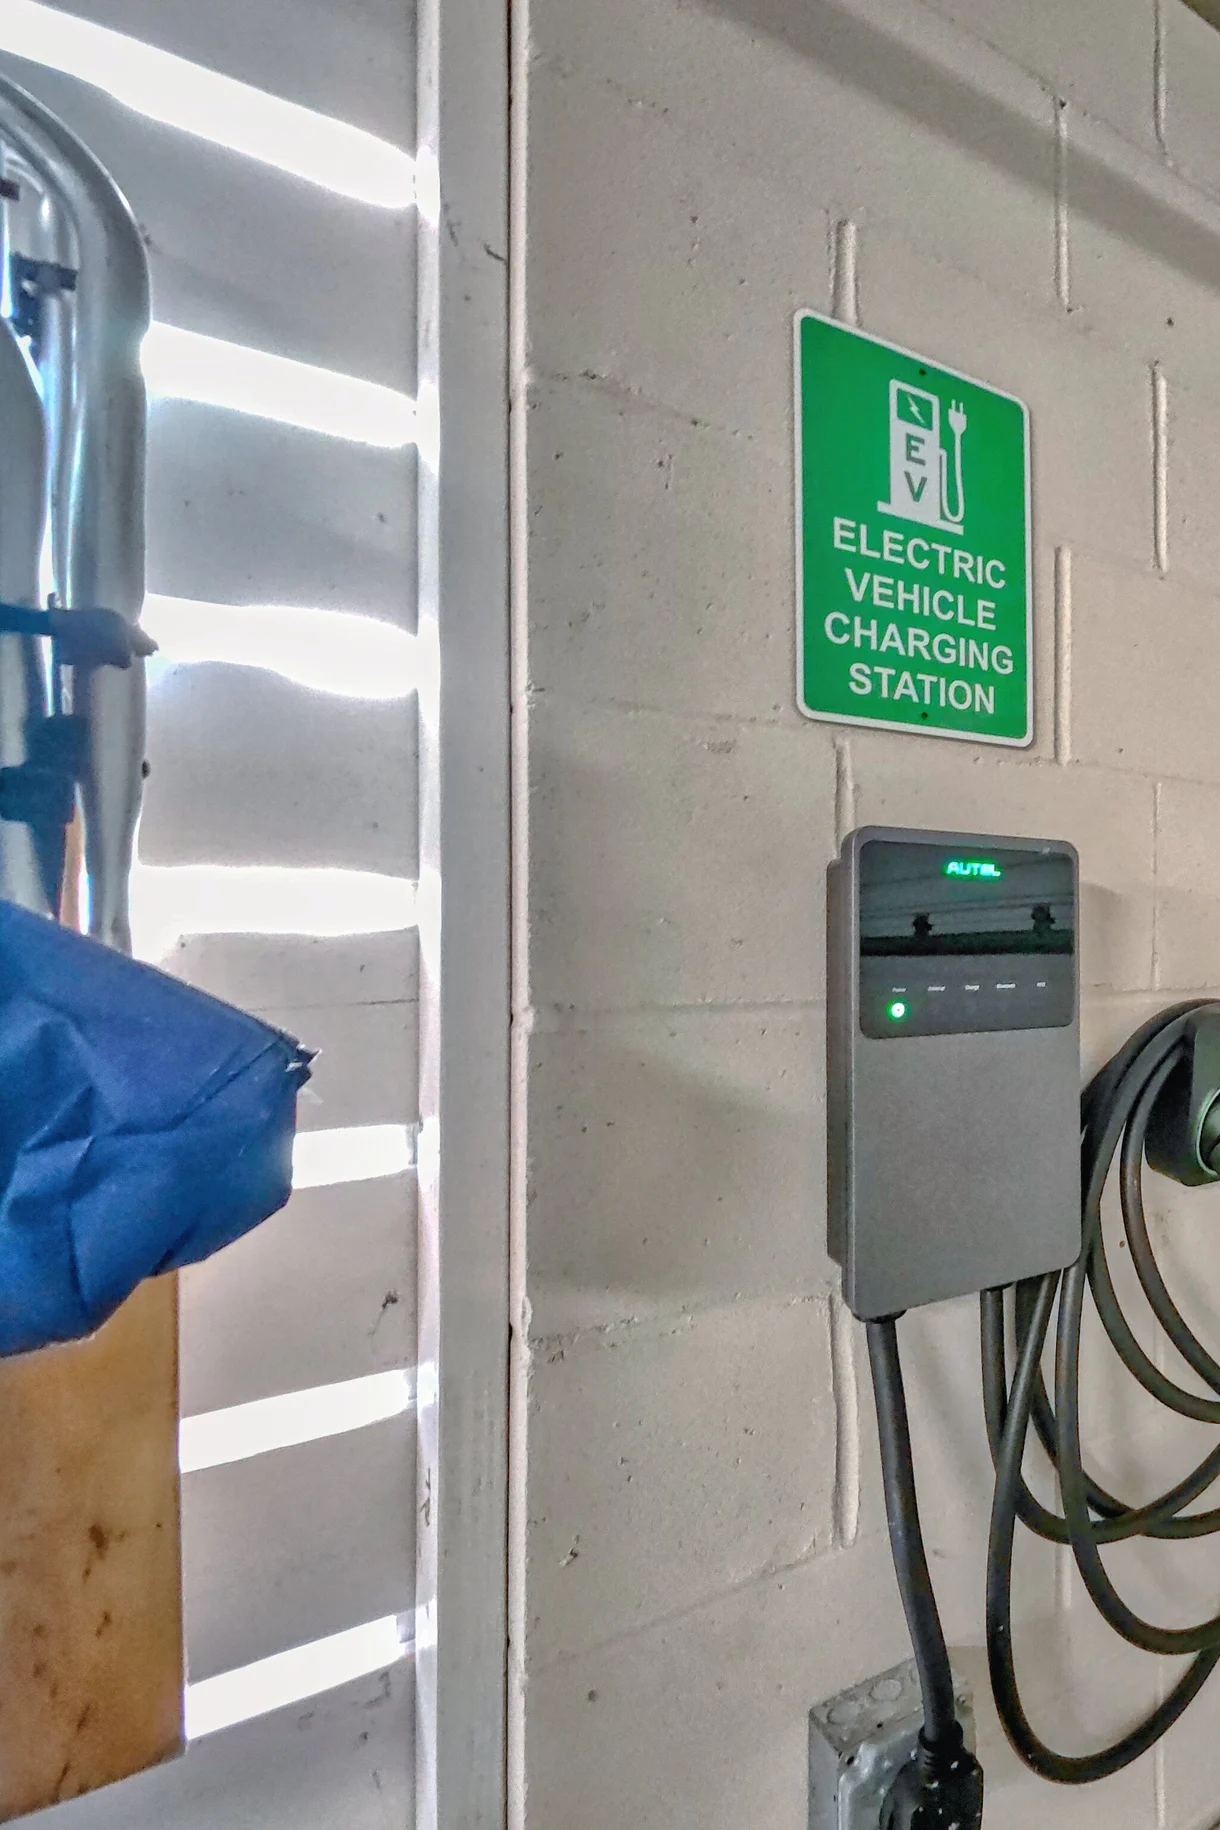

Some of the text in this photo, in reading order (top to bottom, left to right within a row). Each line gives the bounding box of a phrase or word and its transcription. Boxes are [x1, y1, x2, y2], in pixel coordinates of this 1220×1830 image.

[833, 516, 1006, 589] ELECTRIC
[844, 567, 997, 631] VEHICLE
[824, 611, 1014, 675] CHARGING
[848, 662, 995, 715] STATION
